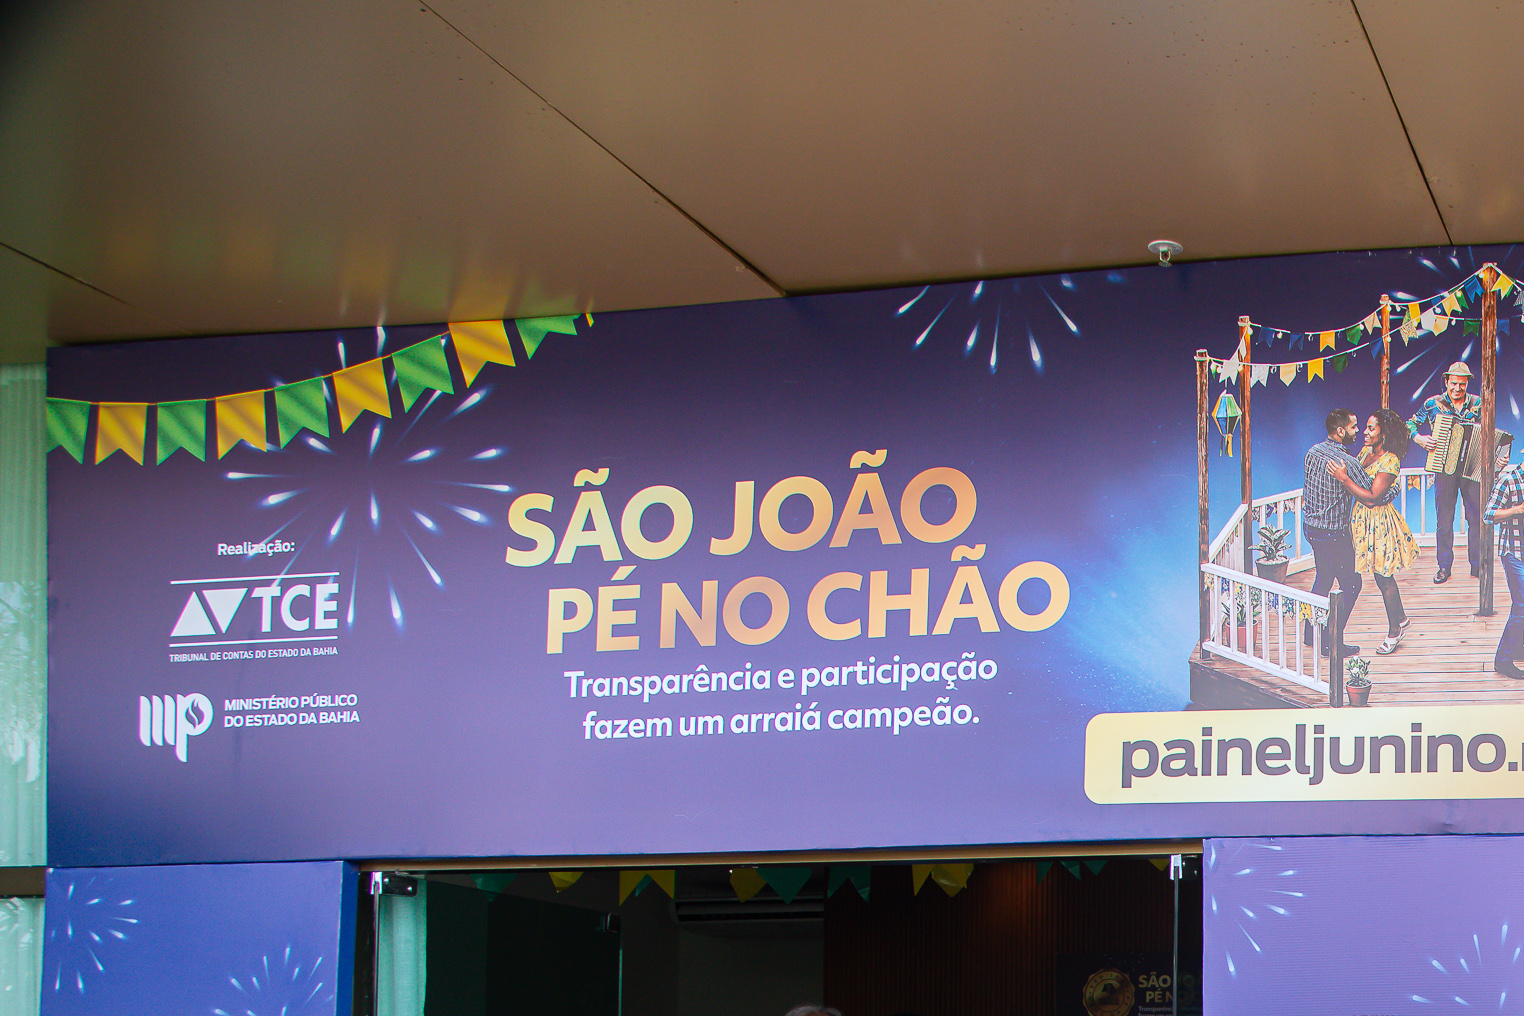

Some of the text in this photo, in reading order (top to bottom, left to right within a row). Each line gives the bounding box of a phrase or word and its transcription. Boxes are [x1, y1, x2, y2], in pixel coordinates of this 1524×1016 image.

[505, 449, 978, 567] SÃO JOÃO
[217, 540, 296, 557] Realização:
[251, 583, 339, 633] TCE
[546, 543, 1071, 654] PÉ NO CHÃO
[169, 646, 338, 663] TRIBUNAL DE CONTAS DO ESTADO DA BAHIA
[564, 651, 999, 703] Transparência e participação
[224, 692, 358, 712] MINISTÉRIO PÚBLICO
[224, 710, 361, 728] DO ESTADO DA BAHIA
[582, 696, 980, 740] fazem um arraiá campeão.
[1138, 971, 1172, 989] SÃO
[1146, 988, 1163, 1003] PÉ
